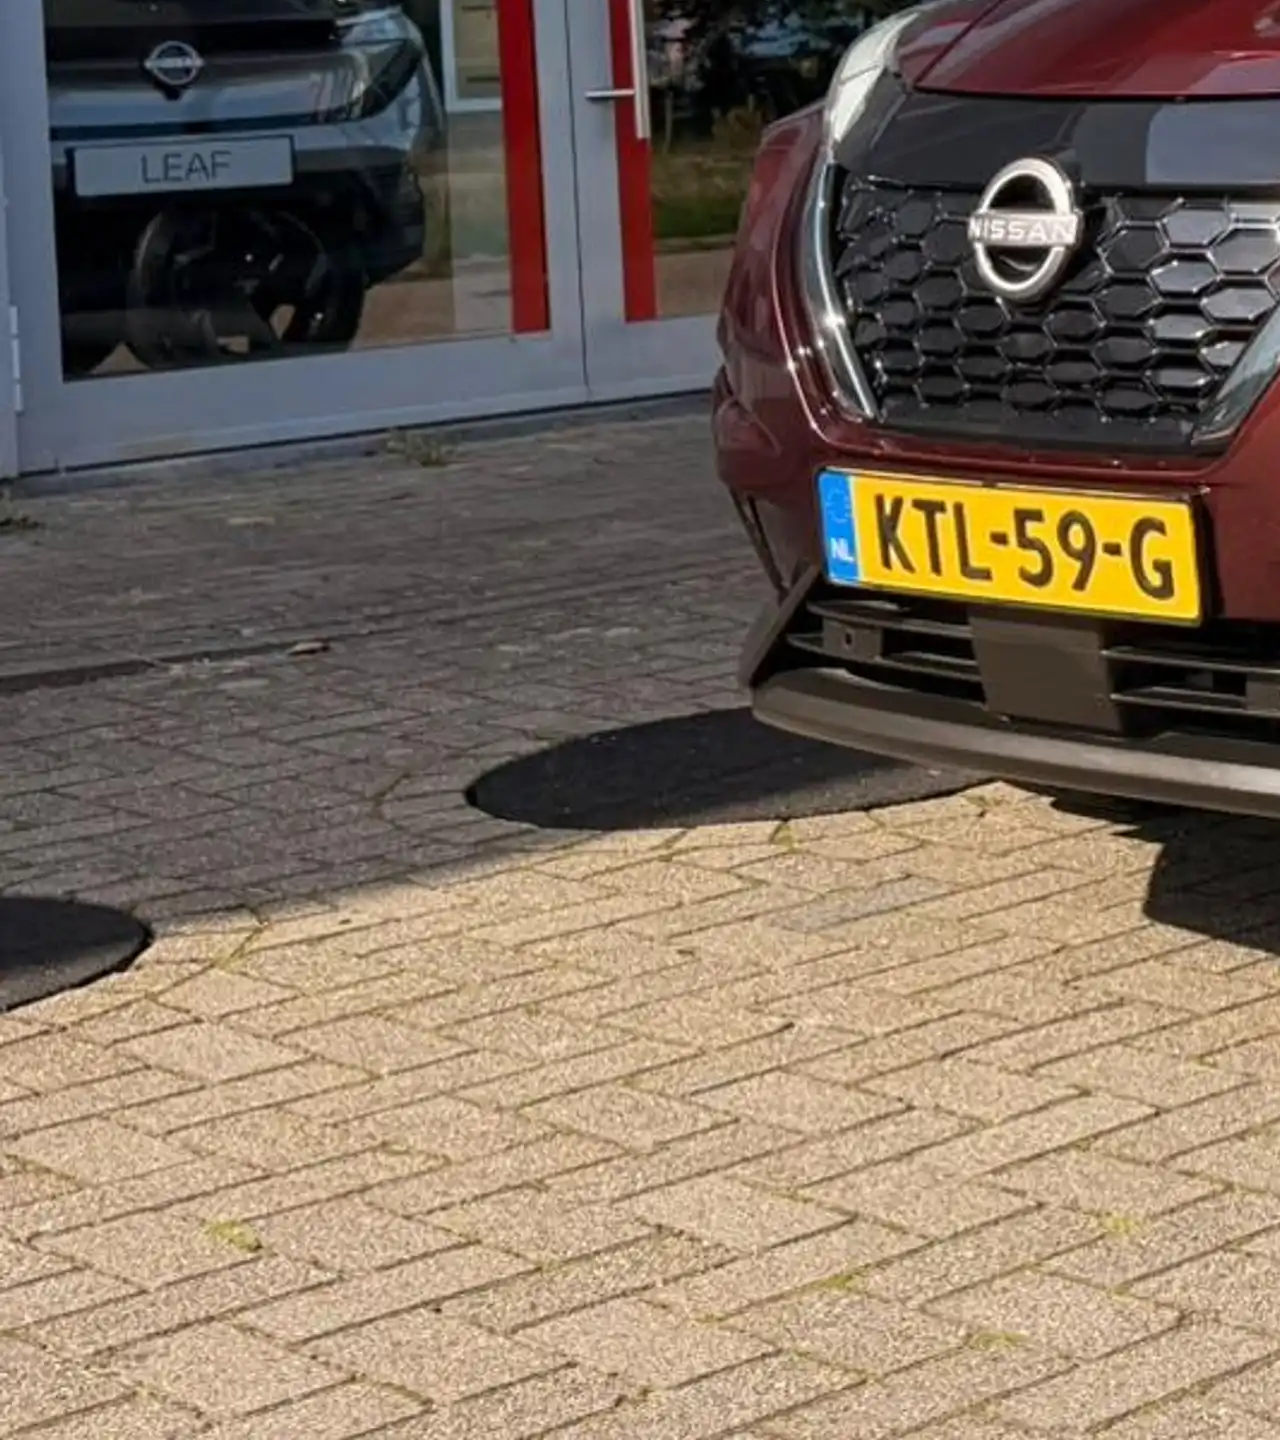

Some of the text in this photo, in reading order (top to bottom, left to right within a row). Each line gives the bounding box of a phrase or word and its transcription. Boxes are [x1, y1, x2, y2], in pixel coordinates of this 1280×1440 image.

[141, 150, 232, 185] LEAF
[968, 216, 1076, 244] NISSAN
[831, 538, 855, 563] NL
[874, 493, 1175, 600] KTL-59-G
